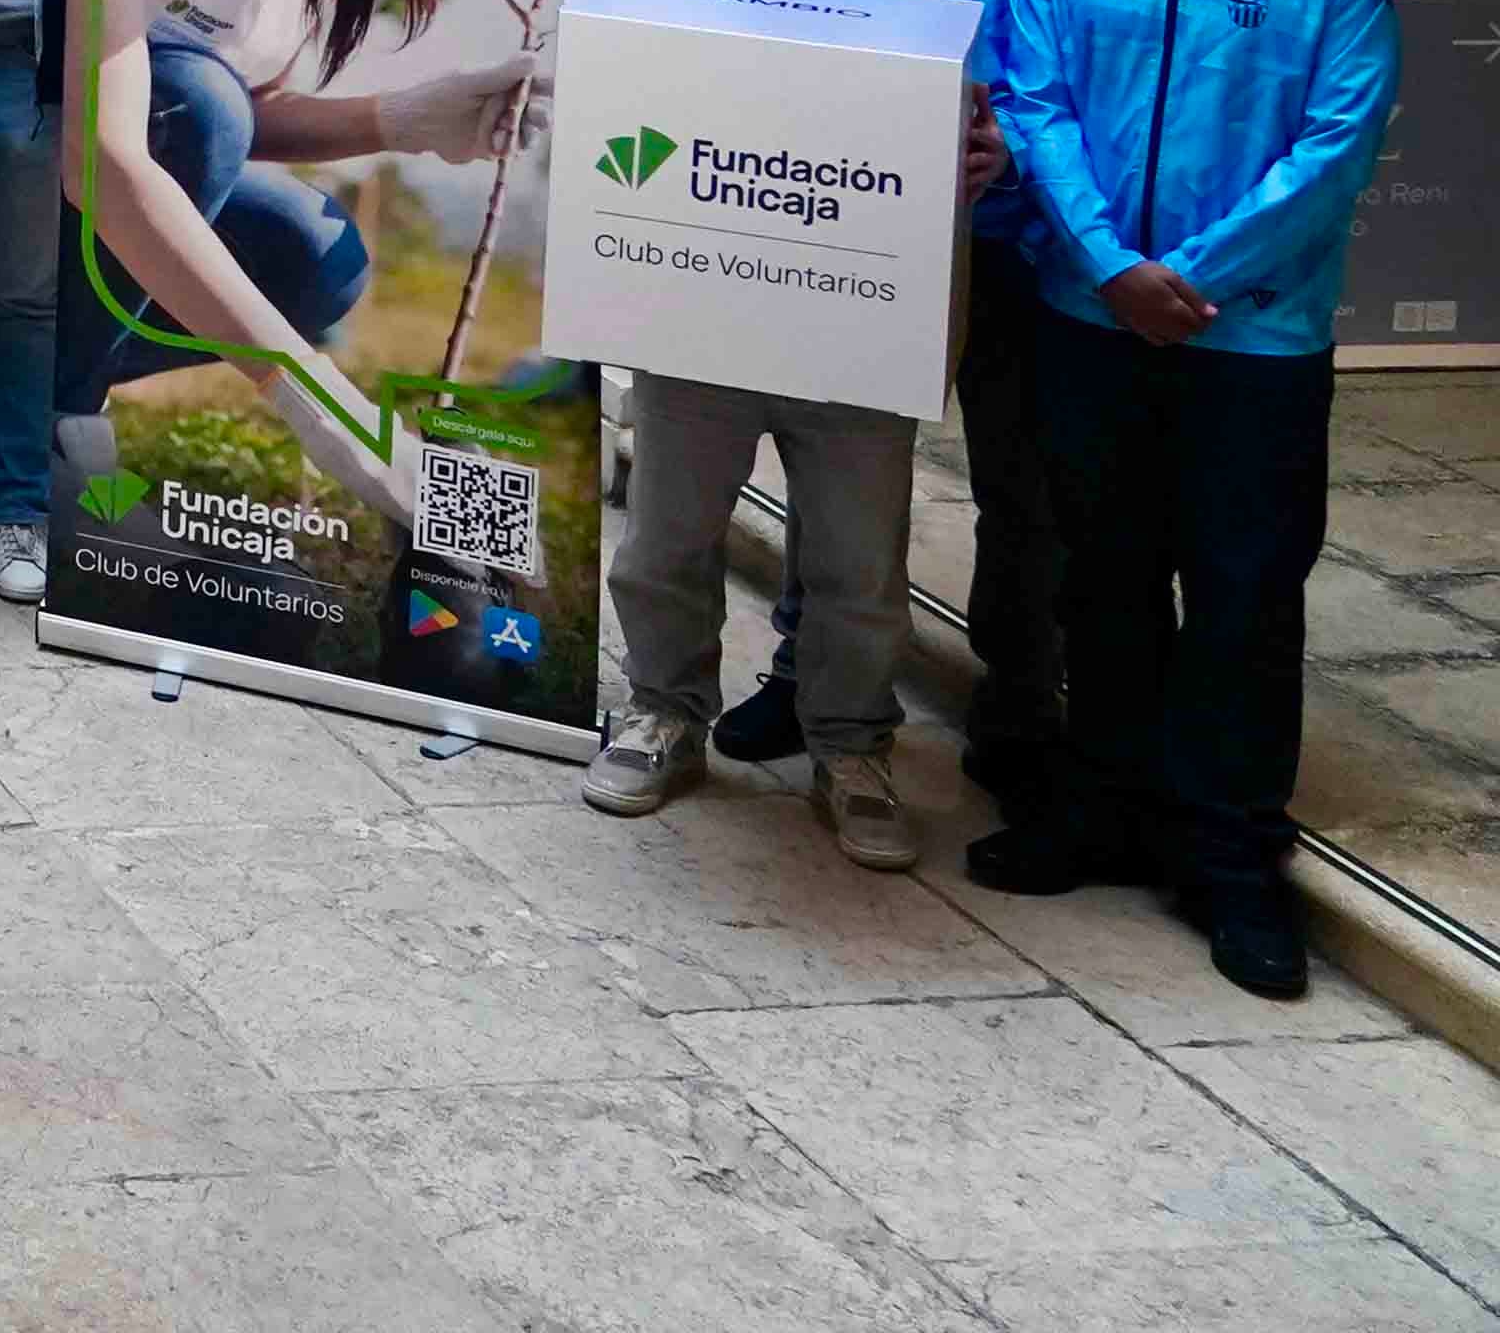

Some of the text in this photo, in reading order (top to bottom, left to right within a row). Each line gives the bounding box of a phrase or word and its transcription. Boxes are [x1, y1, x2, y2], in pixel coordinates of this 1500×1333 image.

[691, 137, 903, 197] Fundación
[690, 172, 840, 226] Unicaja
[593, 233, 897, 302] Club de Voluntarios
[160, 507, 295, 565] Unicaja
[161, 479, 349, 543] Fundación
[74, 547, 346, 625] Club de Voluntarios
